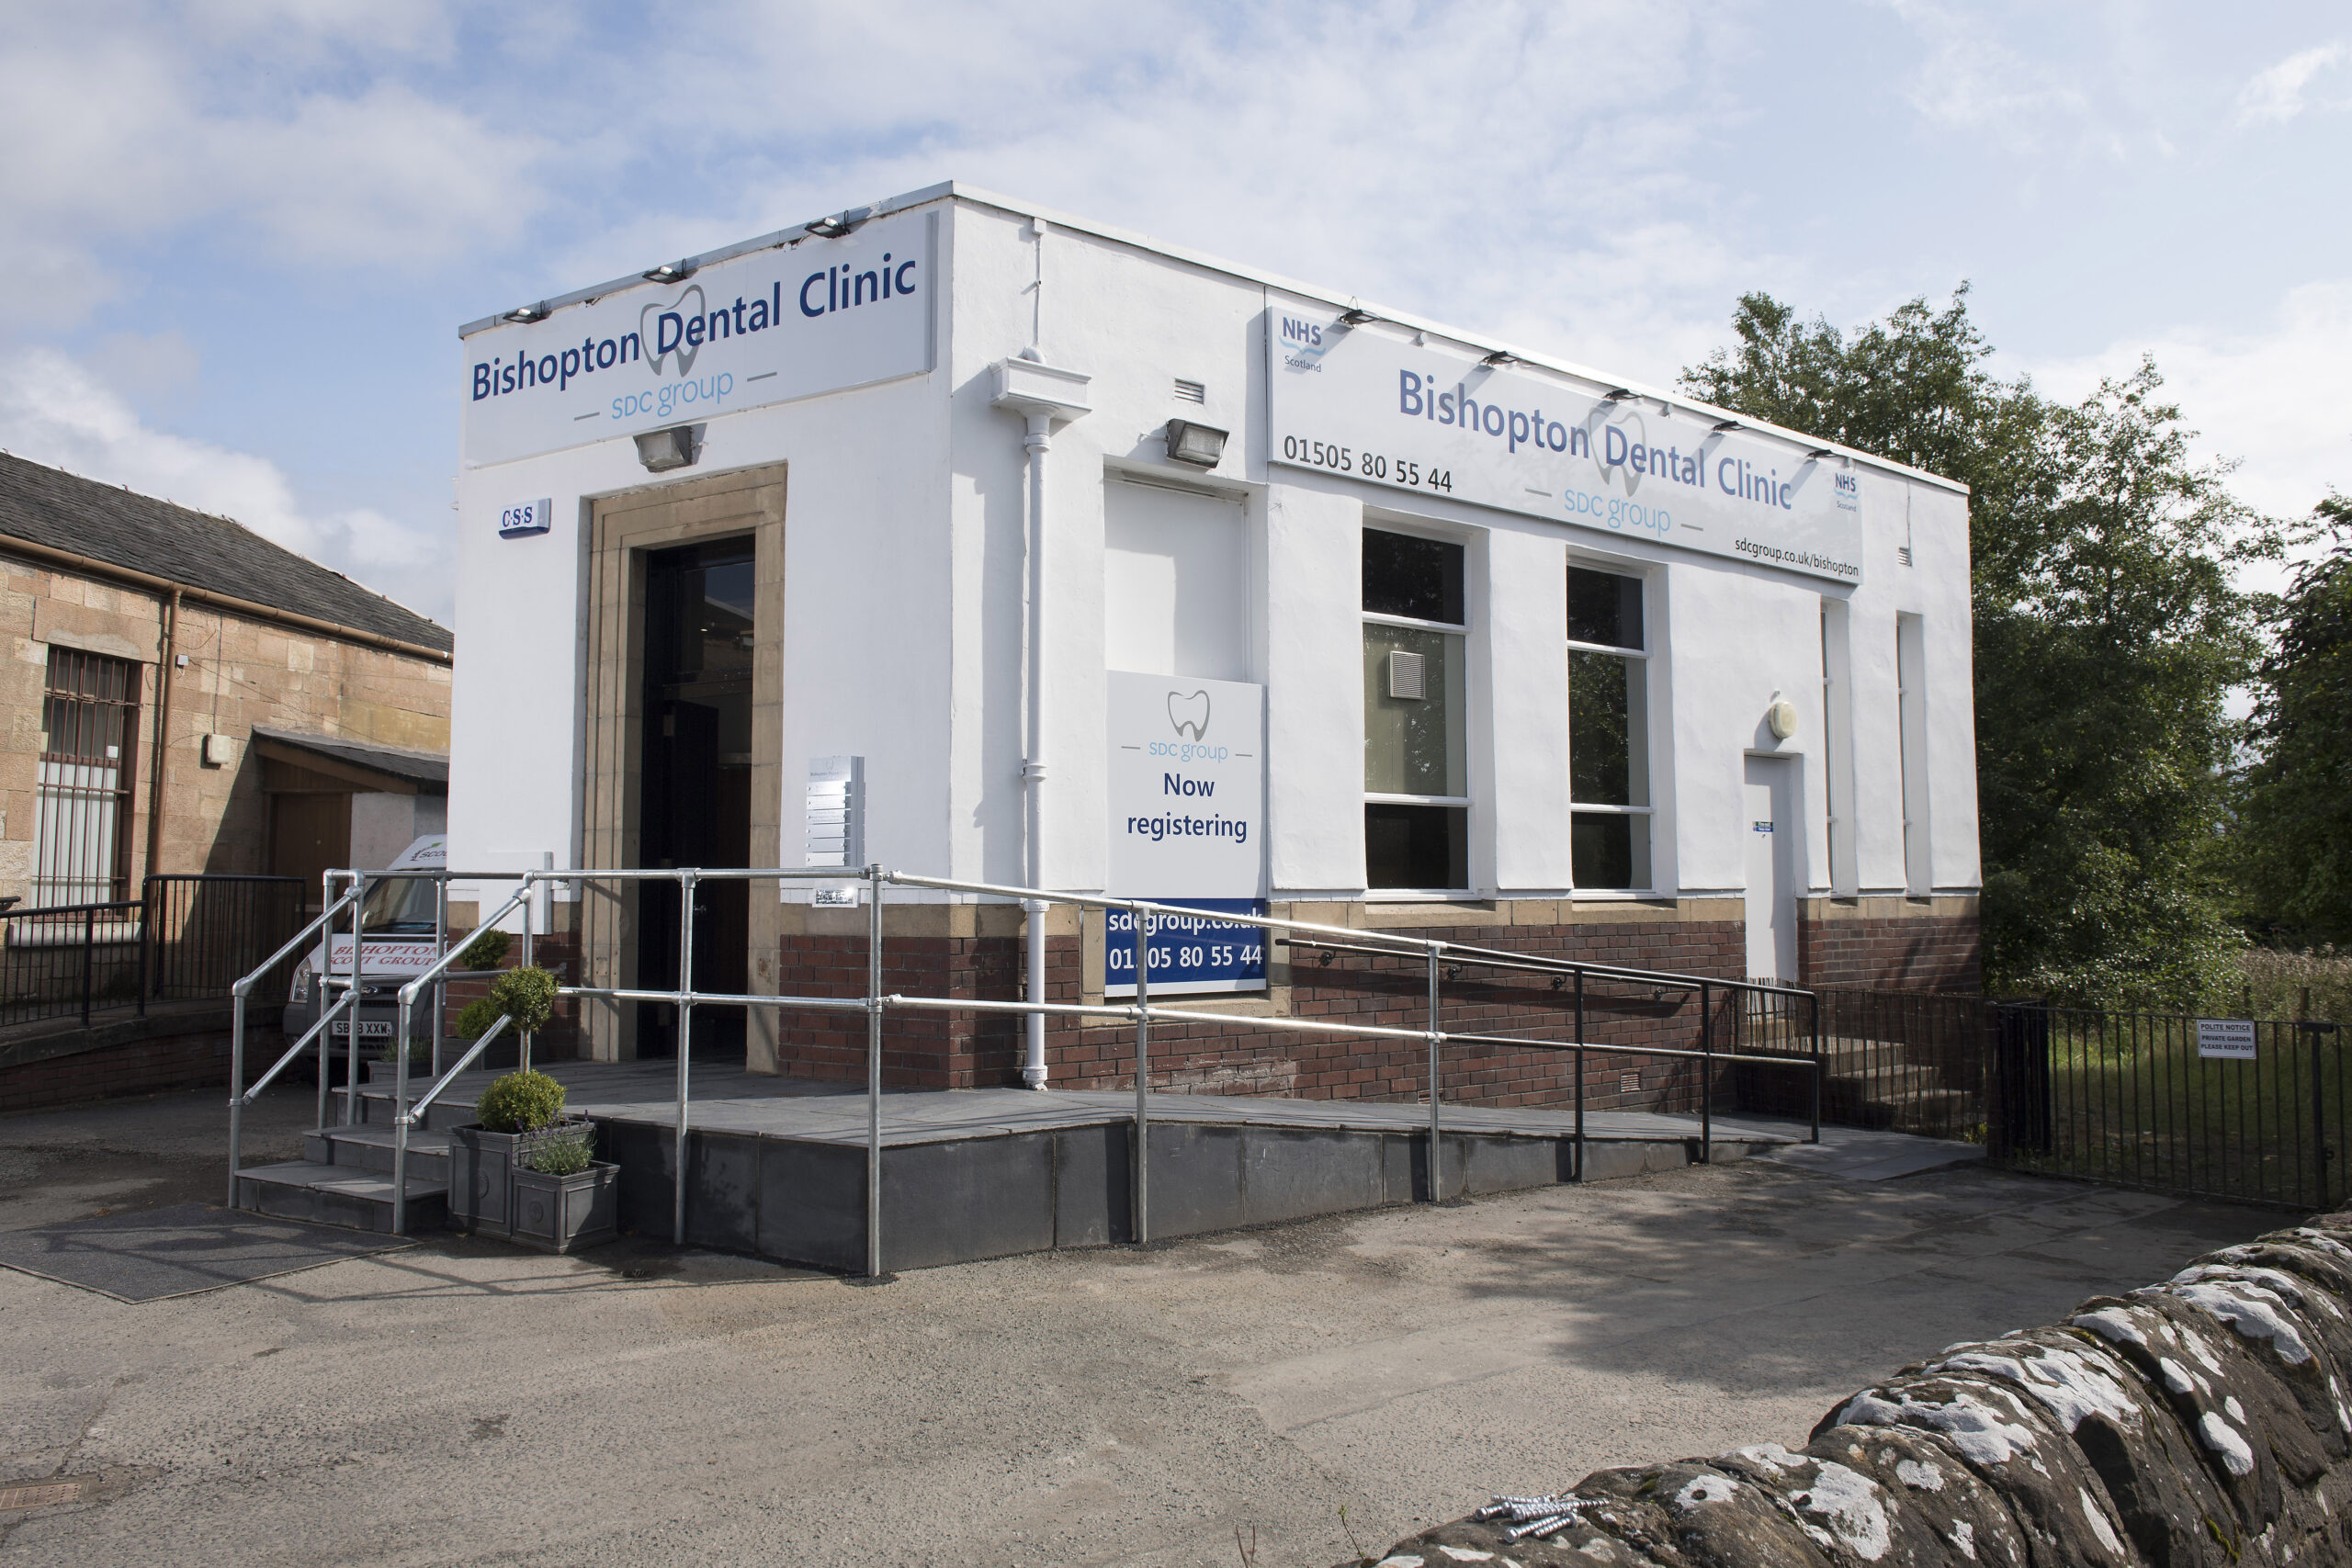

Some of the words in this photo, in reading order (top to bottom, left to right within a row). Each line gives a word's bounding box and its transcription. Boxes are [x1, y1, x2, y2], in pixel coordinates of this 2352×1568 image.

[472, 332, 640, 401] Bishopton
[657, 280, 781, 355] Dental
[799, 252, 916, 318] Clinic
[1283, 316, 1322, 346] NHS
[1284, 355, 1322, 373] Scotland
[657, 372, 734, 418] group
[1399, 368, 1589, 454] Bishopton
[1605, 424, 1705, 488] Dental
[1717, 457, 1792, 510] Clinic
[1283, 434, 1352, 471] 01505
[1361, 452, 1387, 479] 80
[1396, 459, 1419, 486] 55
[1428, 468, 1453, 493] 44
[1835, 472, 1857, 492] NHS
[1608, 498, 1671, 537] group
[1837, 501, 1857, 513] Scotland
[1735, 536, 1860, 577] sdcgroup.co.uk/bishopton
[1181, 743, 1228, 764] group
[1164, 773, 1216, 797] Now
[1127, 811, 1248, 844] registering
[331, 956, 375, 964] COT
[379, 956, 437, 965] GROUP
[334, 945, 437, 955] BIHOPTO
[1109, 947, 1171, 970] 0105
[1179, 946, 1204, 967] 80
[1211, 945, 1233, 966] 55
[1239, 944, 1262, 964] 44
[367, 1022, 387, 1034] XXW
